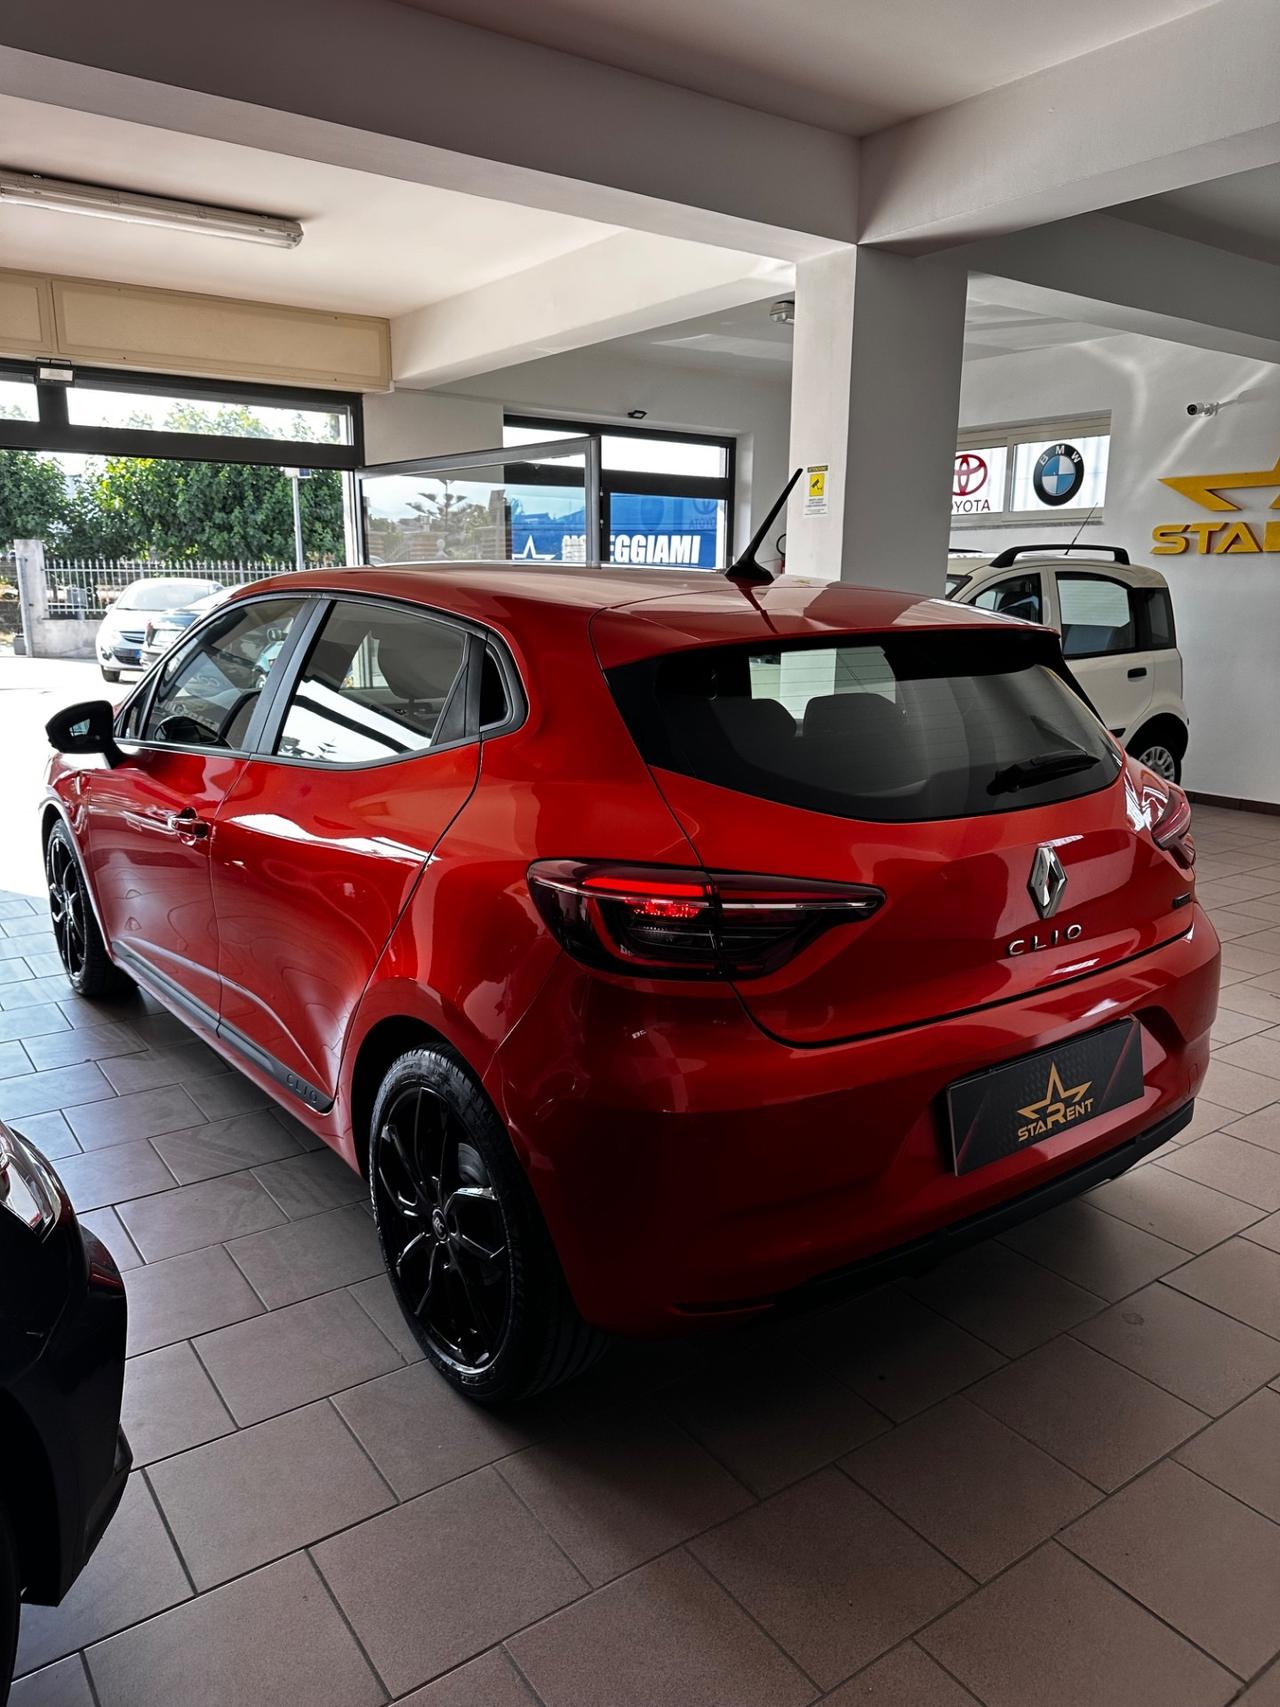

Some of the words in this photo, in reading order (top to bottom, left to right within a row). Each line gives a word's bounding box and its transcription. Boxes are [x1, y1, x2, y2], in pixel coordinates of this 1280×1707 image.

[1039, 444, 1081, 466] BMW
[951, 499, 991, 513] YOTA
[1151, 520, 1280, 555] STA
[1007, 923, 1082, 956] CLIO
[285, 1073, 318, 1104] CLIO
